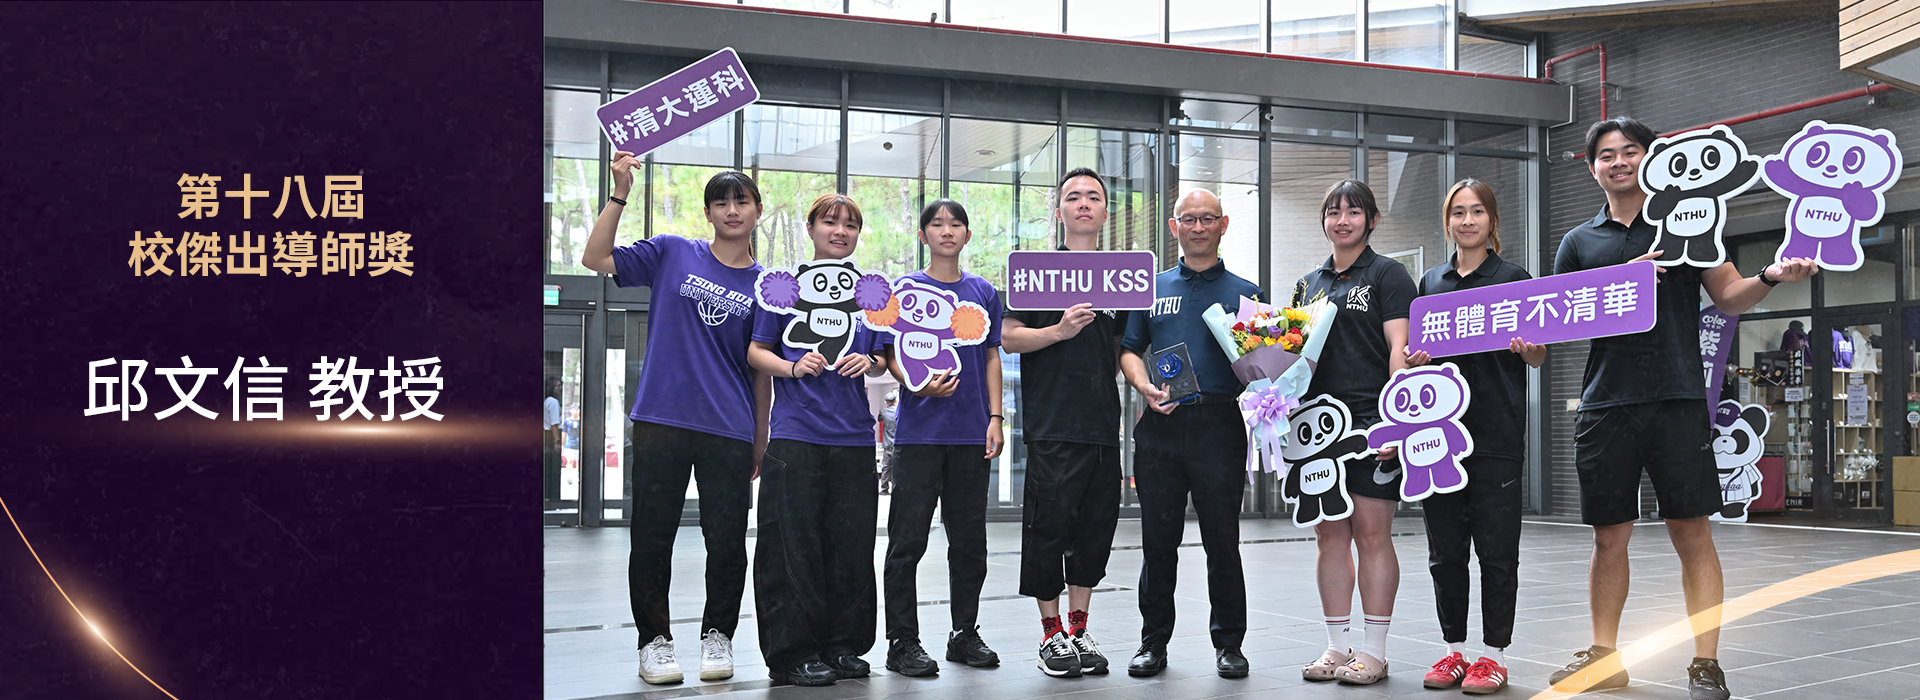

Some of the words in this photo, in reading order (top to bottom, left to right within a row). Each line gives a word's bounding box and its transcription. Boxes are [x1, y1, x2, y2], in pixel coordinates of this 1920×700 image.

[609, 65, 746, 146] #清大運科
[1674, 209, 1707, 222] NTHU
[1805, 209, 1842, 222] NTHU
[1012, 268, 1093, 293] #NTHU
[1103, 268, 1149, 293] KSS
[685, 273, 727, 296] TSING
[725, 290, 754, 308] HUA
[680, 283, 752, 320] UNIVERSITY
[1149, 295, 1183, 318] NTHU
[1346, 303, 1368, 312] NTHU
[1421, 280, 1639, 344] 無體育不清華
[816, 317, 842, 326] NTHU
[908, 340, 933, 349] NTHU
[1412, 438, 1441, 454] NTHU
[1304, 469, 1331, 483] NTHU
